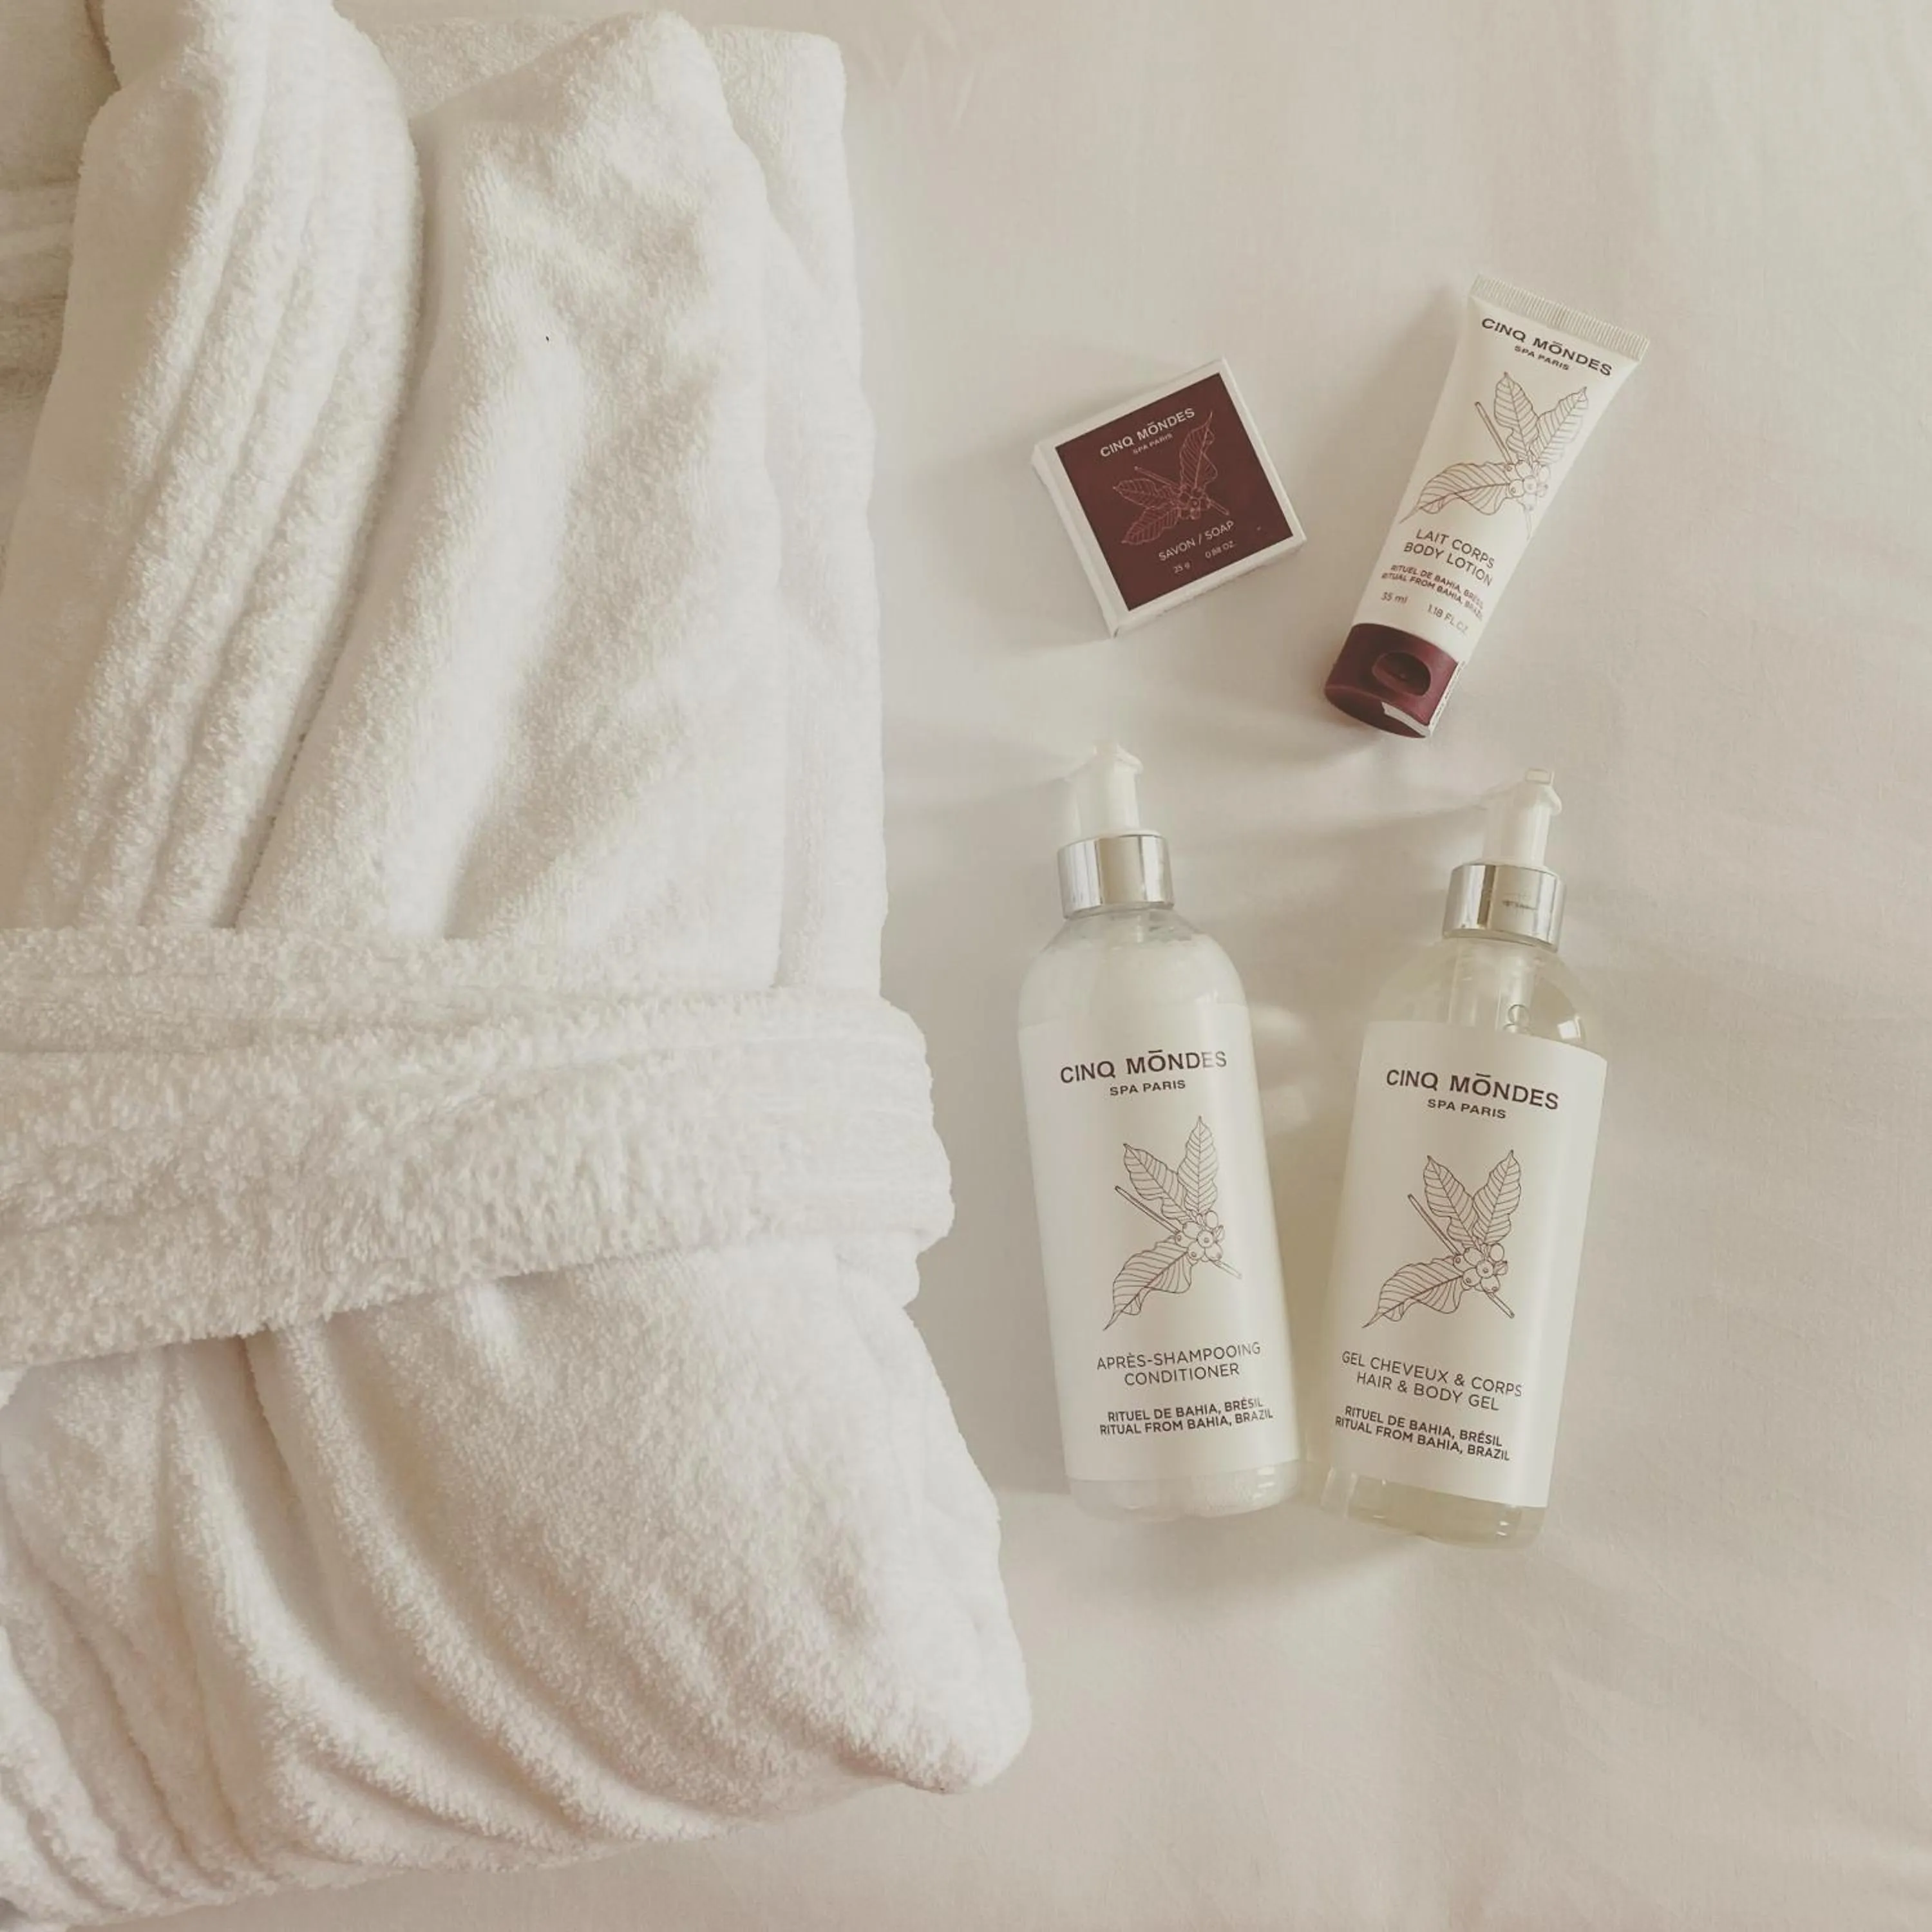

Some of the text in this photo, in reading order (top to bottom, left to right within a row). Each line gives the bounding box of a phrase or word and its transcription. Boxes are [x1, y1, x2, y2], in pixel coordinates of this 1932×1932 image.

[1481, 317, 1526, 343] CINQ
[1514, 345, 1569, 370] SPA PARIS
[1100, 436, 1135, 457] CINQ
[1159, 538, 1196, 561] SAVON
[1204, 520, 1234, 540] SOAP
[1416, 529, 1495, 569] LAIT CORPS
[1390, 565, 1419, 575] RITUEL
[1420, 570, 1433, 579] DE
[1403, 542, 1493, 587] BODY LOTION
[1409, 576, 1435, 589] FROM
[1061, 1049, 1227, 1083] CINQ MŌNDES
[1110, 1080, 1186, 1096] SPA PARIS
[1386, 1069, 1559, 1110] CINQ MŌNDES
[1427, 1098, 1507, 1119] SPA PARIS
[1097, 1341, 1261, 1370] APRÈS-SHAMPOOING
[1124, 1362, 1240, 1386] CONDITIONER
[1341, 1350, 1524, 1397] GEL CHEVEUX & CORPS
[1356, 1371, 1499, 1411] HAIR & BODY GEL
[1099, 1408, 1273, 1435] RITUAL FROM BAHIA, BRAZIL
[1108, 1396, 1263, 1423] RITUEL DE BAHIA, BRÉSIL
[1335, 1416, 1510, 1461] RITUAL FROM BAHIA, BRAZIL
[1345, 1406, 1502, 1448] RITUEL DE BAHIA, BRÉSIL
